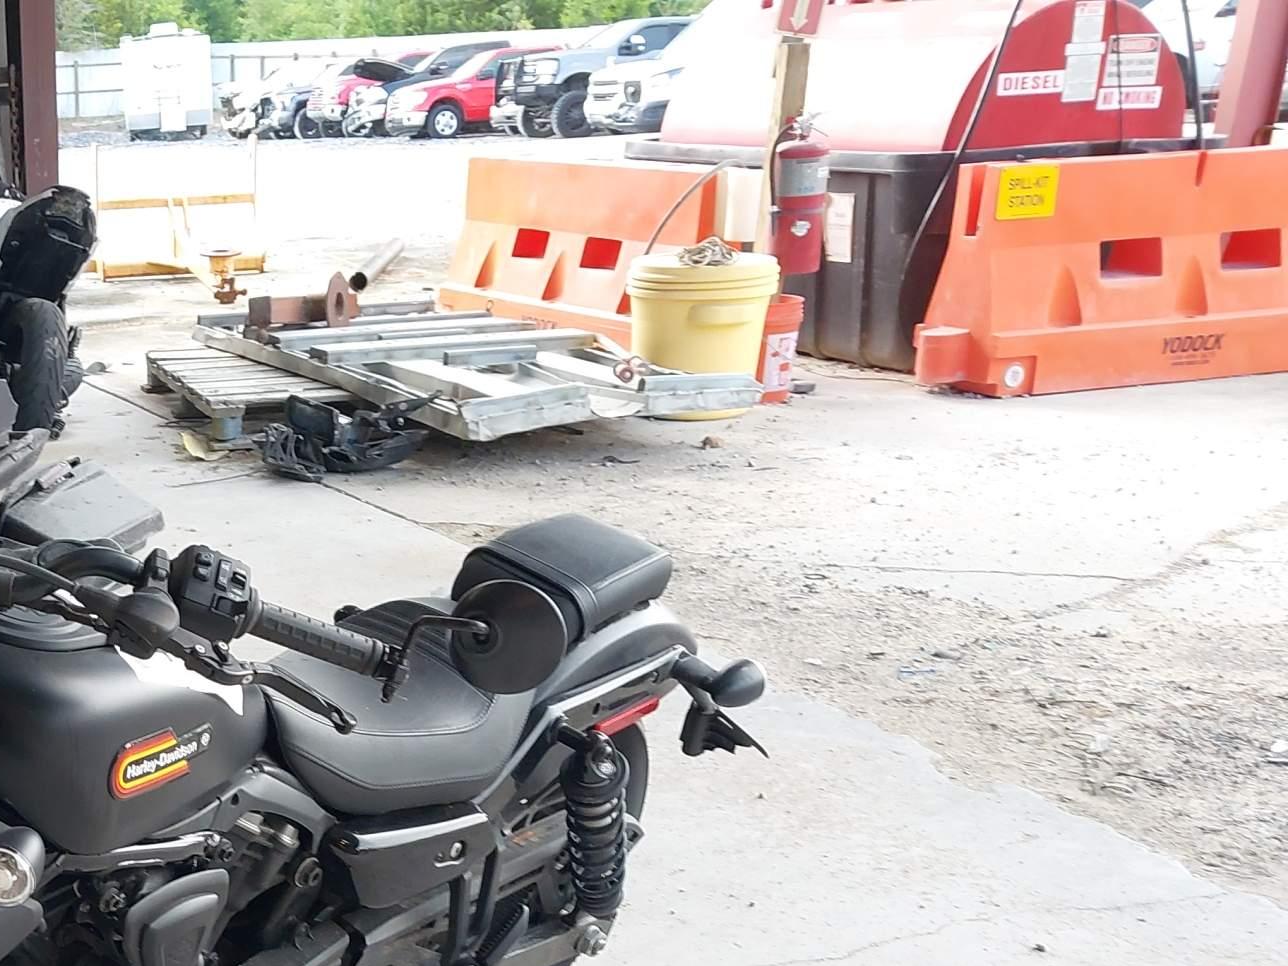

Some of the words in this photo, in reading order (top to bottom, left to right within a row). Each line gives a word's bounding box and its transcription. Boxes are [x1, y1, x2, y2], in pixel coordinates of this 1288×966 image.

[1003, 75, 1059, 91] DIESEL
[1009, 194, 1045, 208] STATION
[1161, 333, 1224, 354] YODOCK
[126, 741, 198, 779] Harley-Davidson
